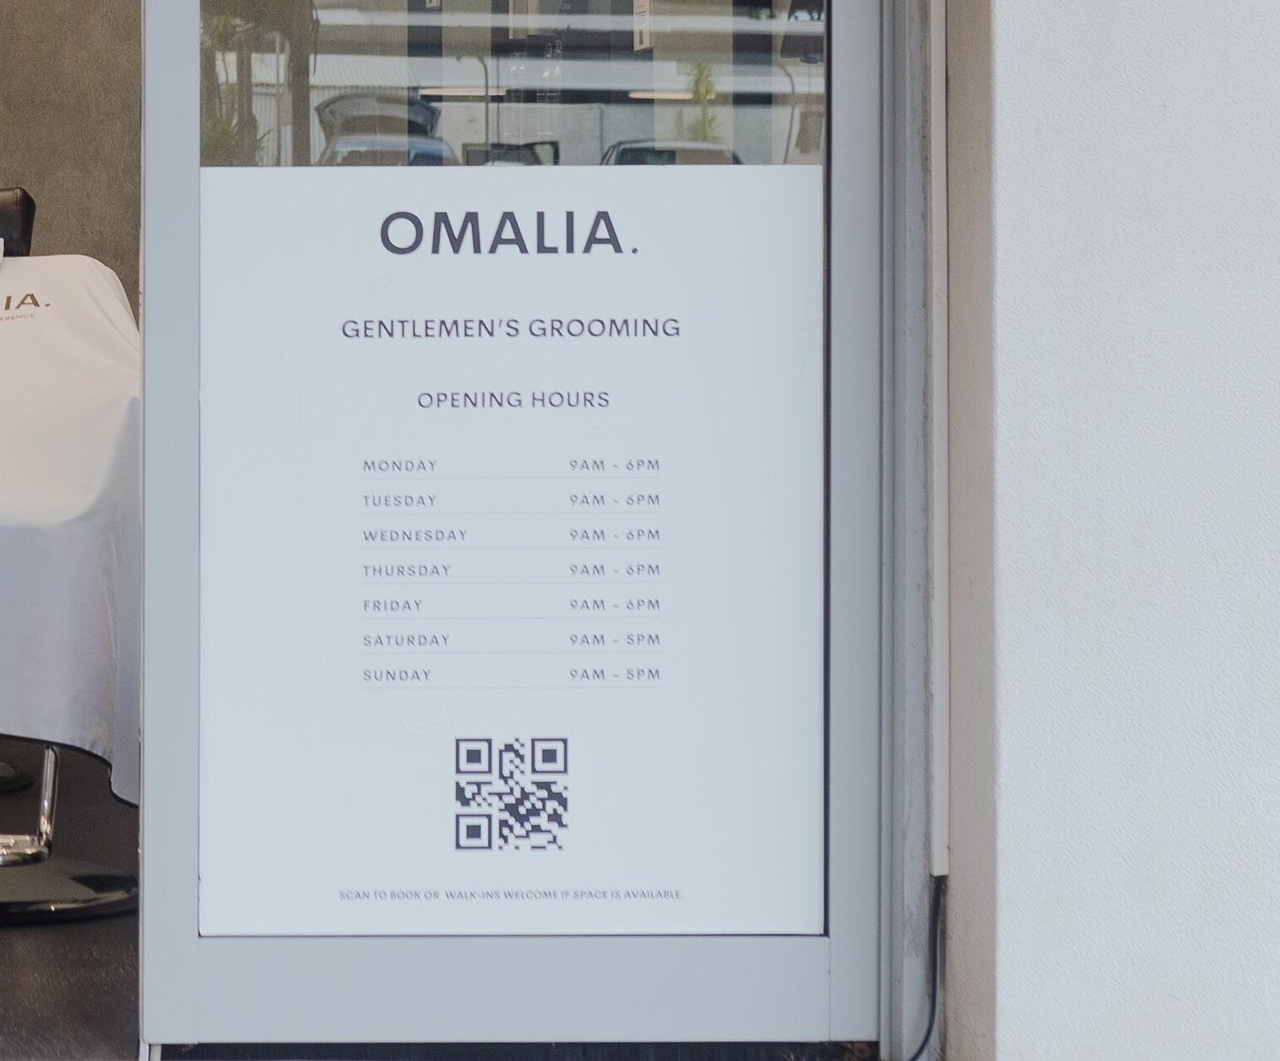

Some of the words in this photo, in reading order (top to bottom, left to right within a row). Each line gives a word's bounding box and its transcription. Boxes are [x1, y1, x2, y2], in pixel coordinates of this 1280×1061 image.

[379, 210, 639, 255] OMALIA.
[341, 319, 520, 339] GENTLEMEN'S
[529, 318, 681, 338] GROOMING
[417, 391, 523, 409] OPENING
[531, 391, 610, 409] HOURS
[362, 460, 437, 473] MONDAY
[569, 459, 606, 472] 9AM
[625, 459, 661, 472] 6PM
[362, 495, 437, 508] TUESDAY
[569, 494, 606, 507] 9AM
[625, 494, 661, 507] 6PM
[362, 530, 468, 543] WEDNESDAY
[569, 529, 606, 542] 9AM
[625, 529, 661, 542] 6PM
[362, 565, 451, 578] THURSDAY
[569, 564, 606, 577] 9AM
[625, 564, 661, 577] 6PM
[362, 600, 423, 613] FRIDAY
[569, 599, 606, 612] 9AM
[625, 599, 661, 612] 6PM
[362, 634, 450, 647] SATURDAY
[569, 633, 606, 646] 9AM
[625, 633, 661, 646] 5PM
[362, 669, 431, 682] SUNDAY
[569, 668, 606, 681] 9AM
[625, 668, 661, 681] 5PM
[339, 890, 371, 901] SCAN
[373, 890, 388, 901] TO
[390, 890, 422, 901] BOOK
[424, 890, 441, 901] OR
[503, 890, 559, 901] WELCOME
[561, 890, 571, 900] IF
[573, 890, 609, 900] SPACE
[611, 890, 622, 900] IS
